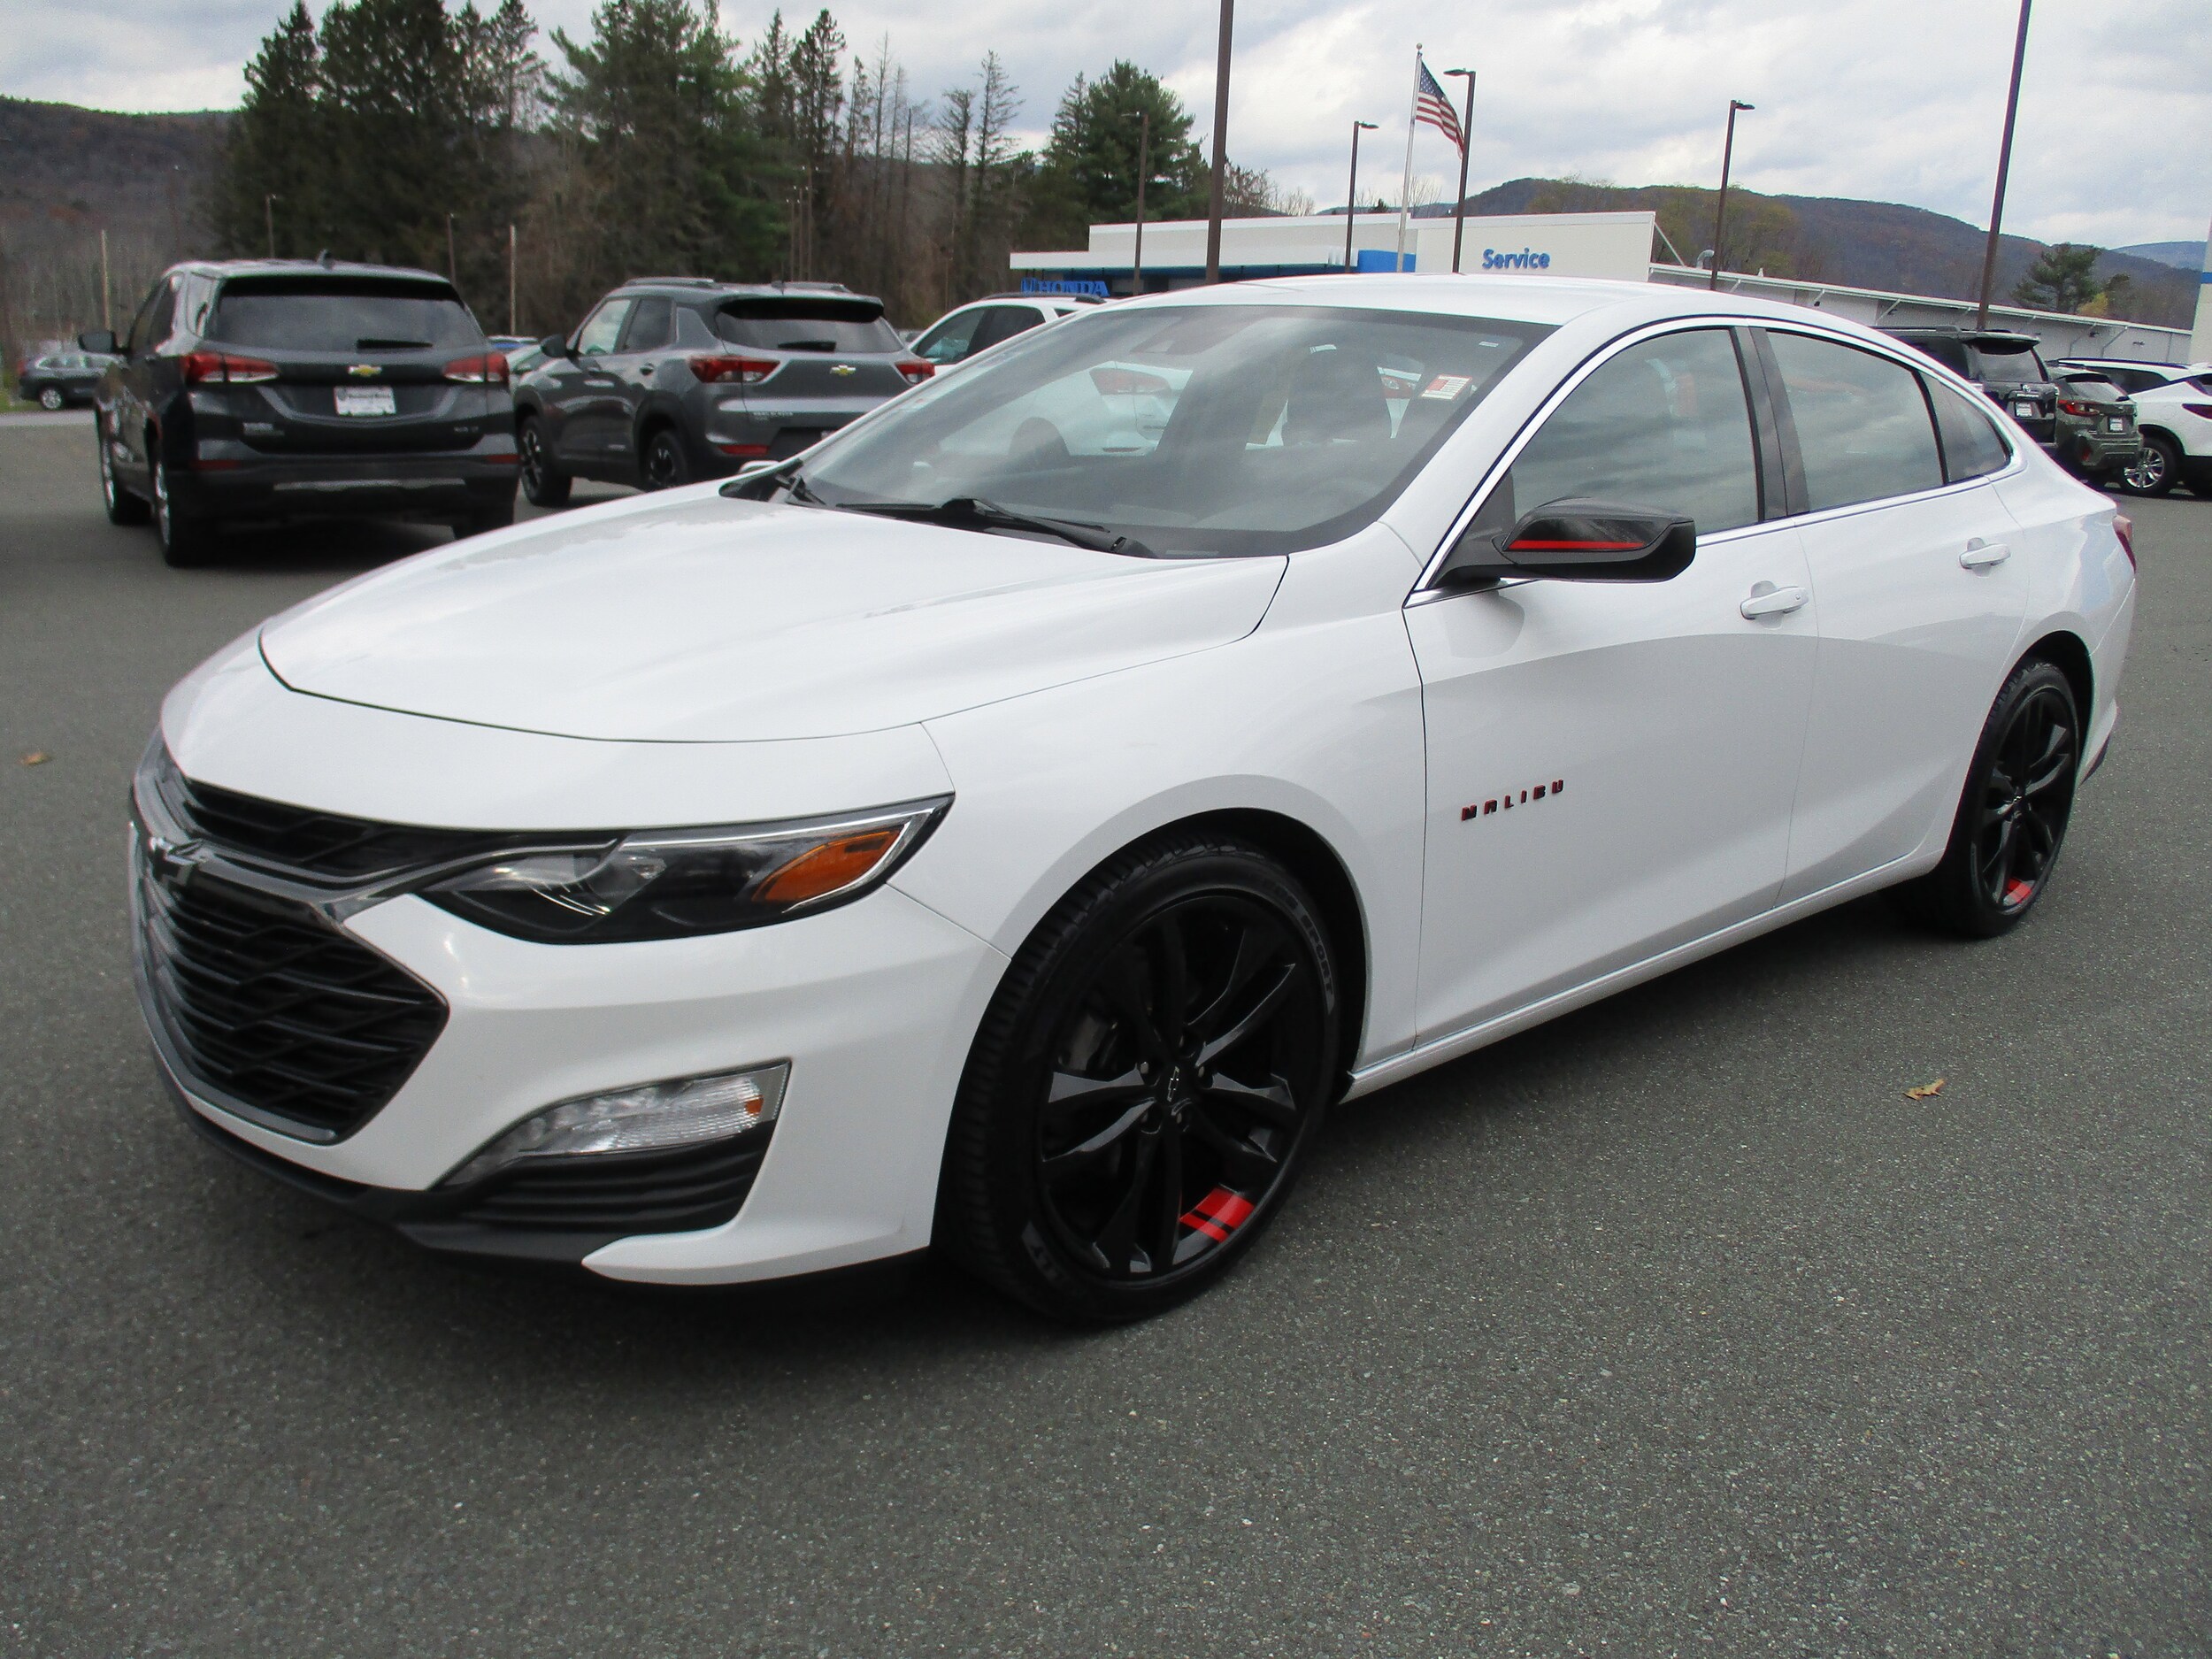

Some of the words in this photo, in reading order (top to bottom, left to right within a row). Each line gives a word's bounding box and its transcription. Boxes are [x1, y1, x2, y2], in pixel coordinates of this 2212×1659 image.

[1482, 247, 1550, 270] Service
[1039, 280, 1110, 297] HONDA
[1462, 779, 1564, 821] MALIBU
